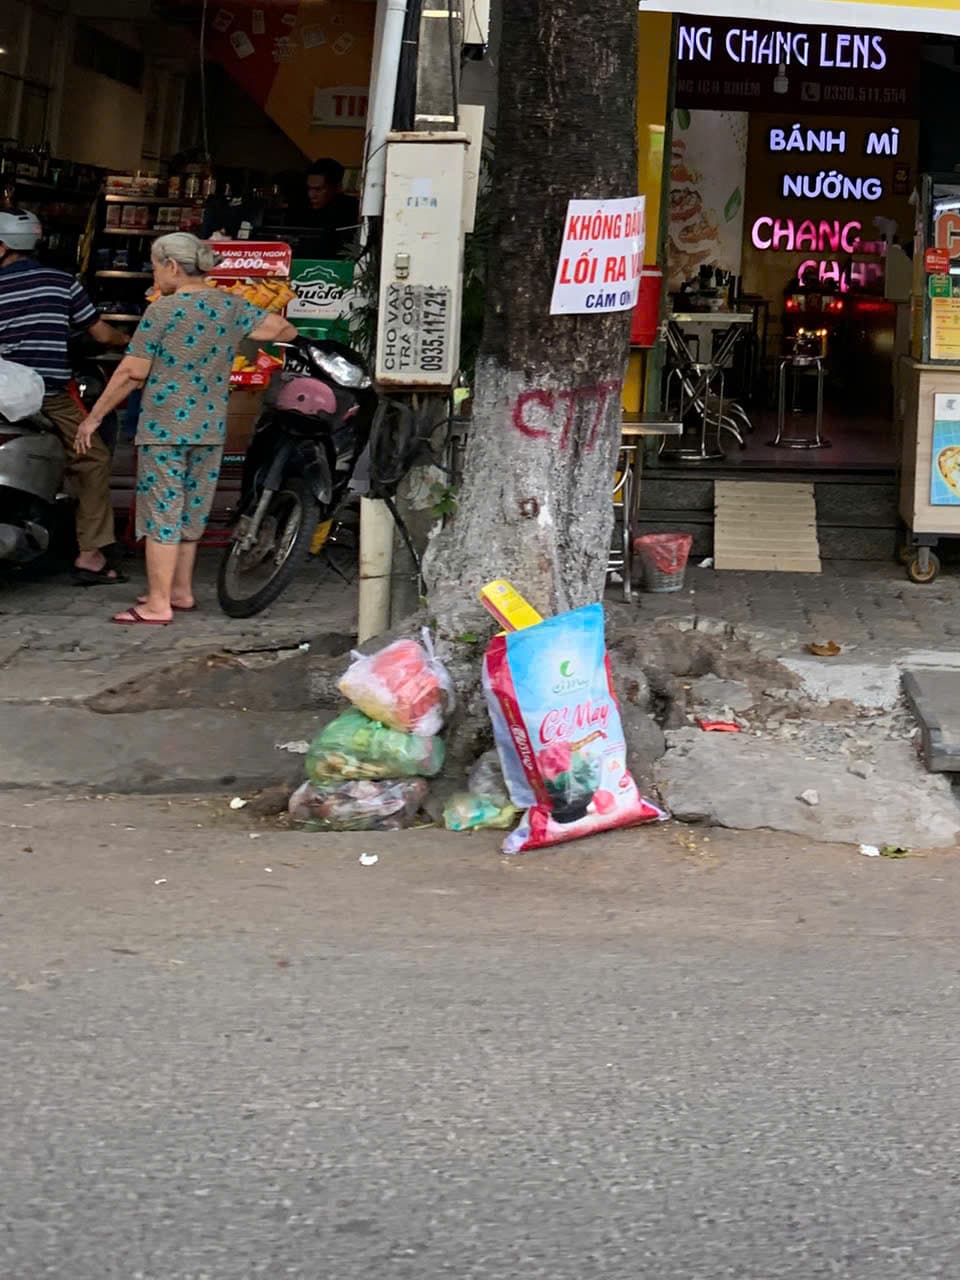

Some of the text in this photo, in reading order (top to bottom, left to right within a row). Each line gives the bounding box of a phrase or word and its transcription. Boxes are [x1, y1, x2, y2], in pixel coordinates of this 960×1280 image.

[725, 29, 809, 67] CHANG
[819, 32, 887, 70] LENS
[769, 123, 900, 155] BÁNH MÌ
[782, 170, 883, 200] NƯỚNG
[567, 209, 622, 240] KHÔNG
[752, 216, 862, 253] CHANG
[559, 248, 598, 284] LỐI
[603, 256, 626, 283] RA
[586, 288, 616, 308] CẢM
[385, 284, 400, 370] CHO VAY
